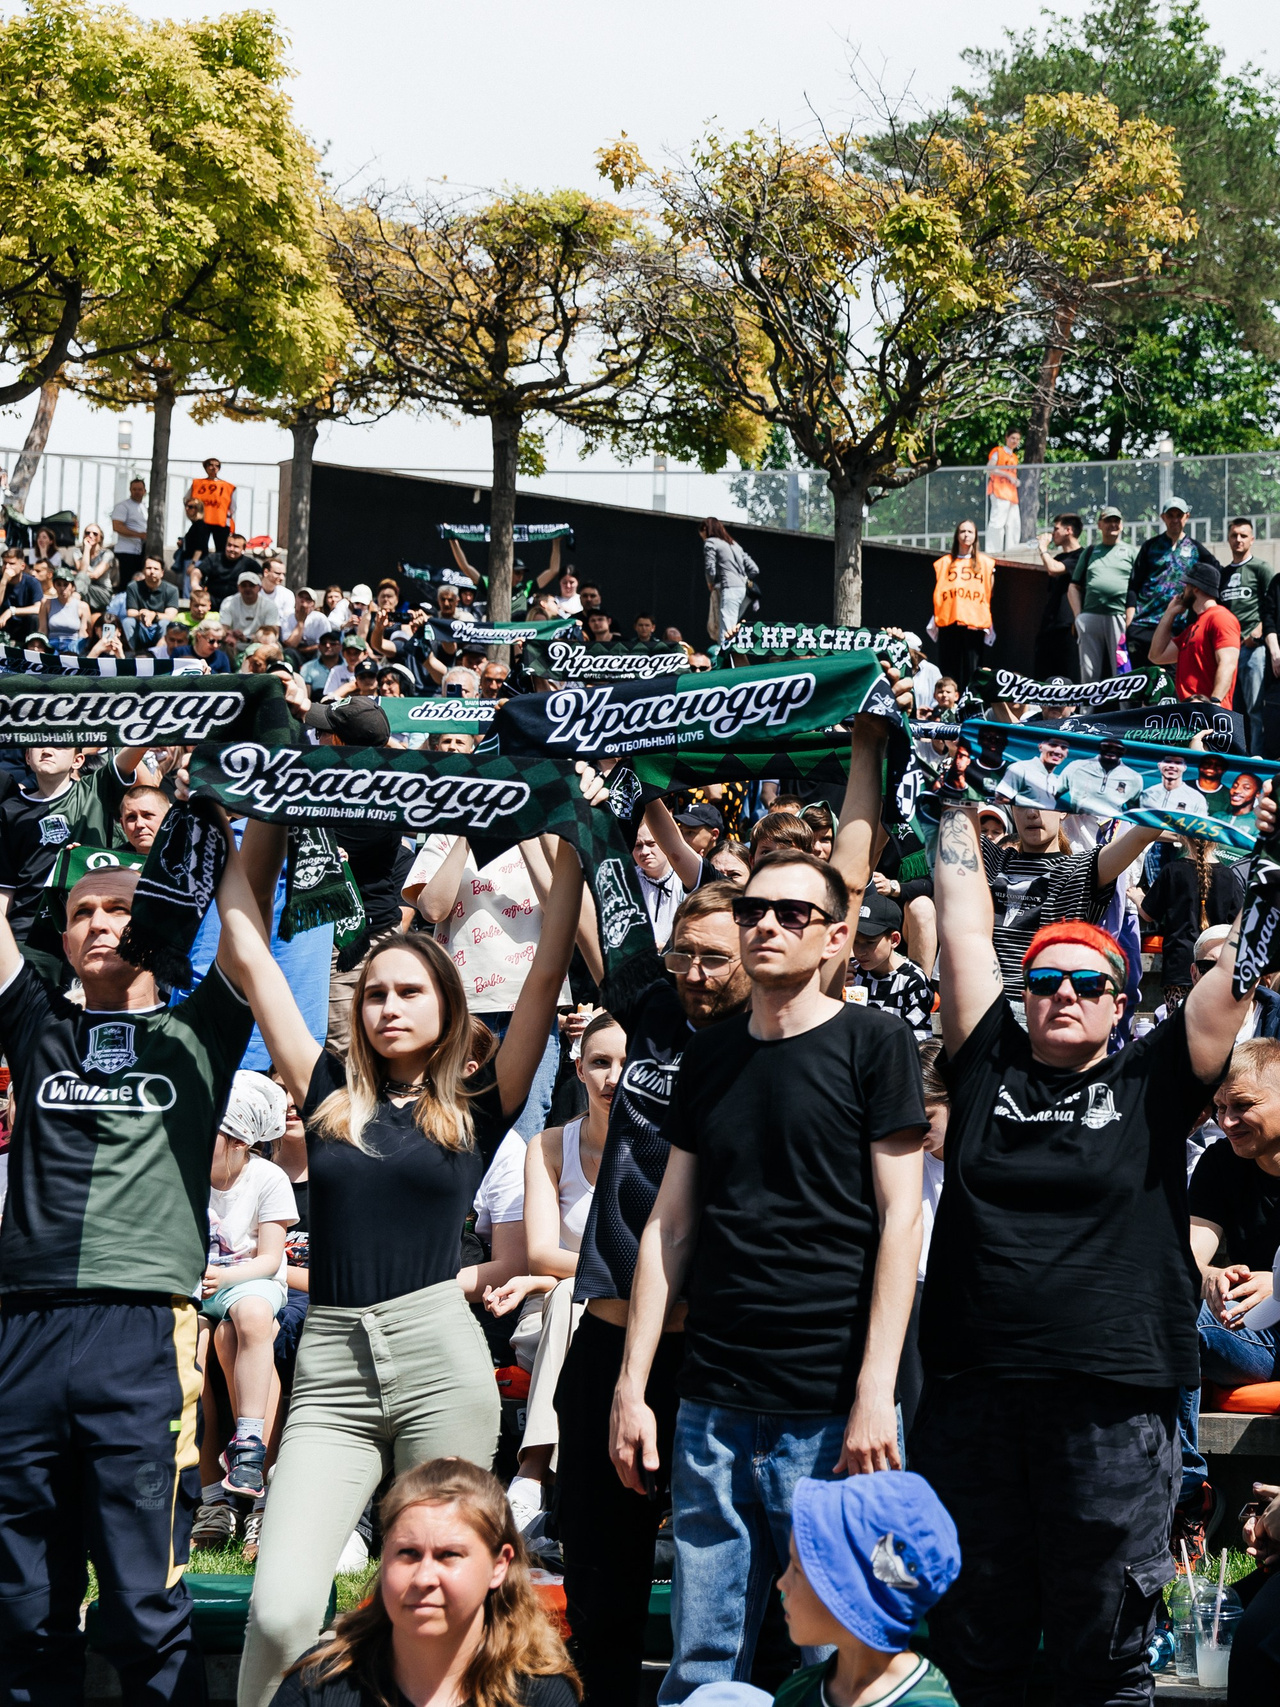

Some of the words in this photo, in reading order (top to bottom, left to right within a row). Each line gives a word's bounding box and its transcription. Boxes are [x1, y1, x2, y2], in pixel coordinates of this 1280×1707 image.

[198, 484, 224, 497] 691
[948, 566, 983, 584] 554
[450, 620, 538, 645] Краснодар
[548, 642, 690, 680] Краснодар
[996, 669, 1148, 705] Краснодар
[546, 672, 817, 752] Краснодар
[77, 731, 108, 743] КЛУБ
[604, 731, 676, 754] ФУТБОЛЬНЫЙ
[677, 729, 705, 744] КЛУБ
[220, 743, 531, 828] Краснодар
[286, 804, 365, 819] ФУТБОЛЬНЫЙ
[367, 808, 397, 822] КЛУБ
[1160, 814, 1224, 838] 24/25
[471, 879, 501, 896] Barbie
[502, 898, 533, 919] Barbie
[472, 925, 503, 945] Barbie
[505, 945, 534, 963] Barbie
[474, 973, 506, 994] Barbie
